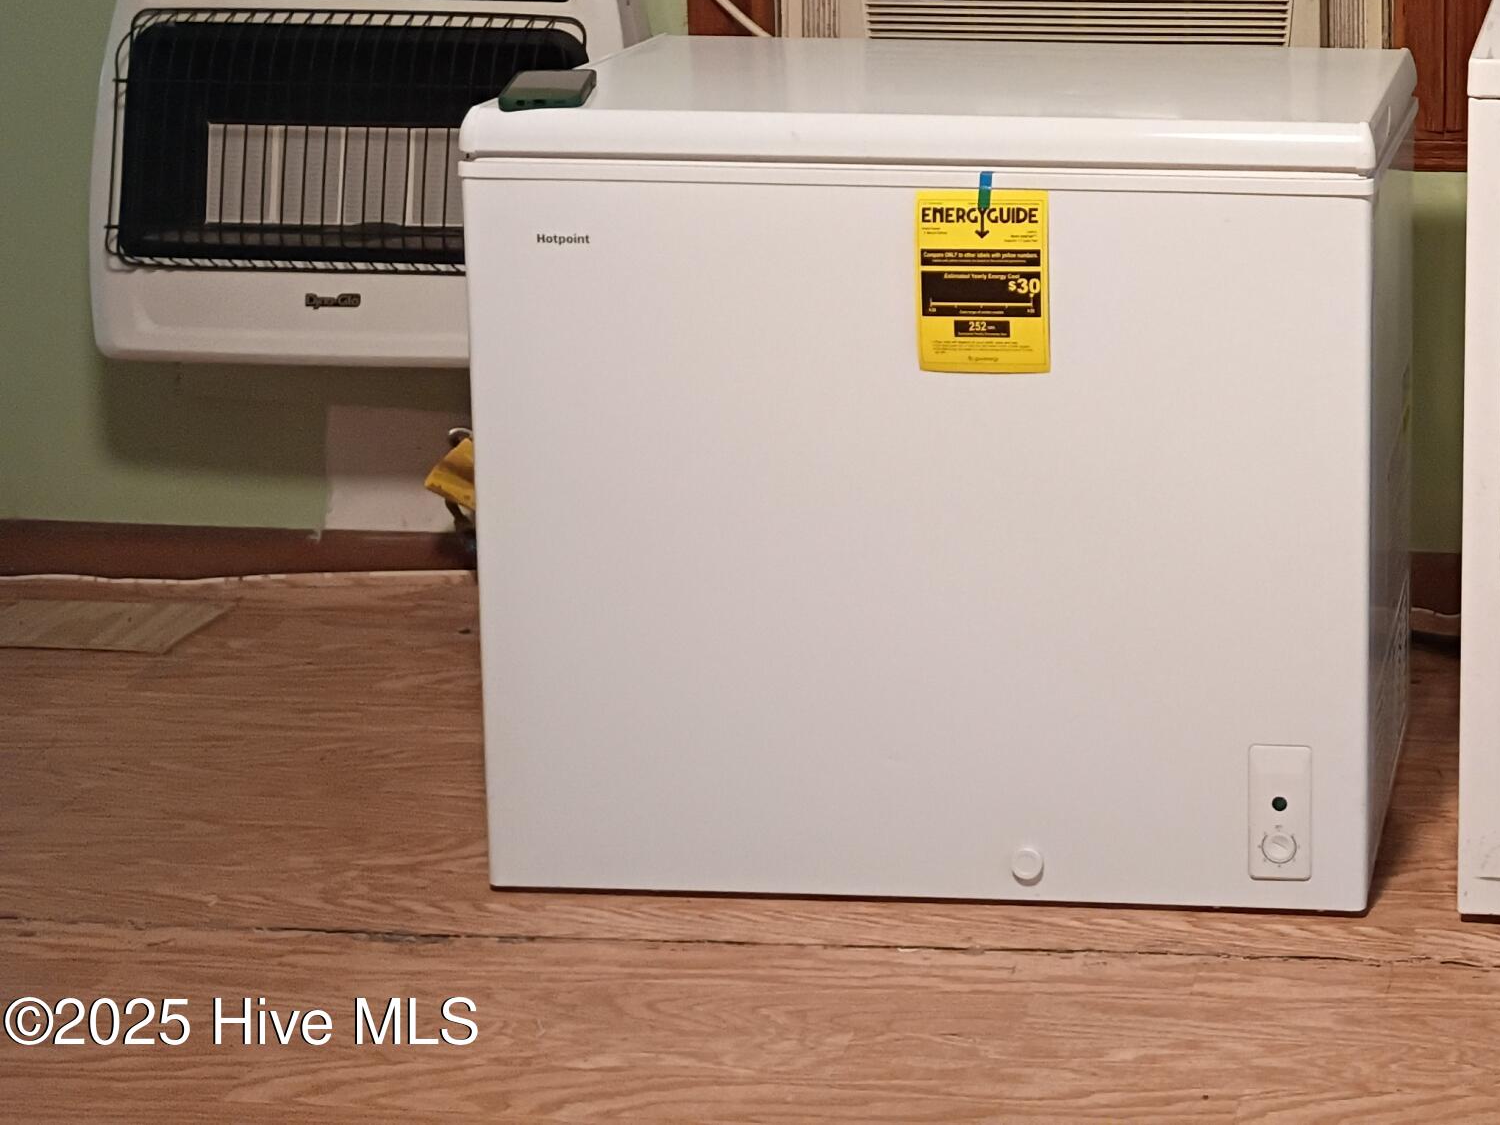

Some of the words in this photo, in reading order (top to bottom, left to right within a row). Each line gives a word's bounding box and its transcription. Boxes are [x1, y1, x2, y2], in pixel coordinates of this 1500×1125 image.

[536, 233, 590, 246] Hotpoint
[1008, 278, 1041, 294] $30
[968, 321, 987, 332] 252
